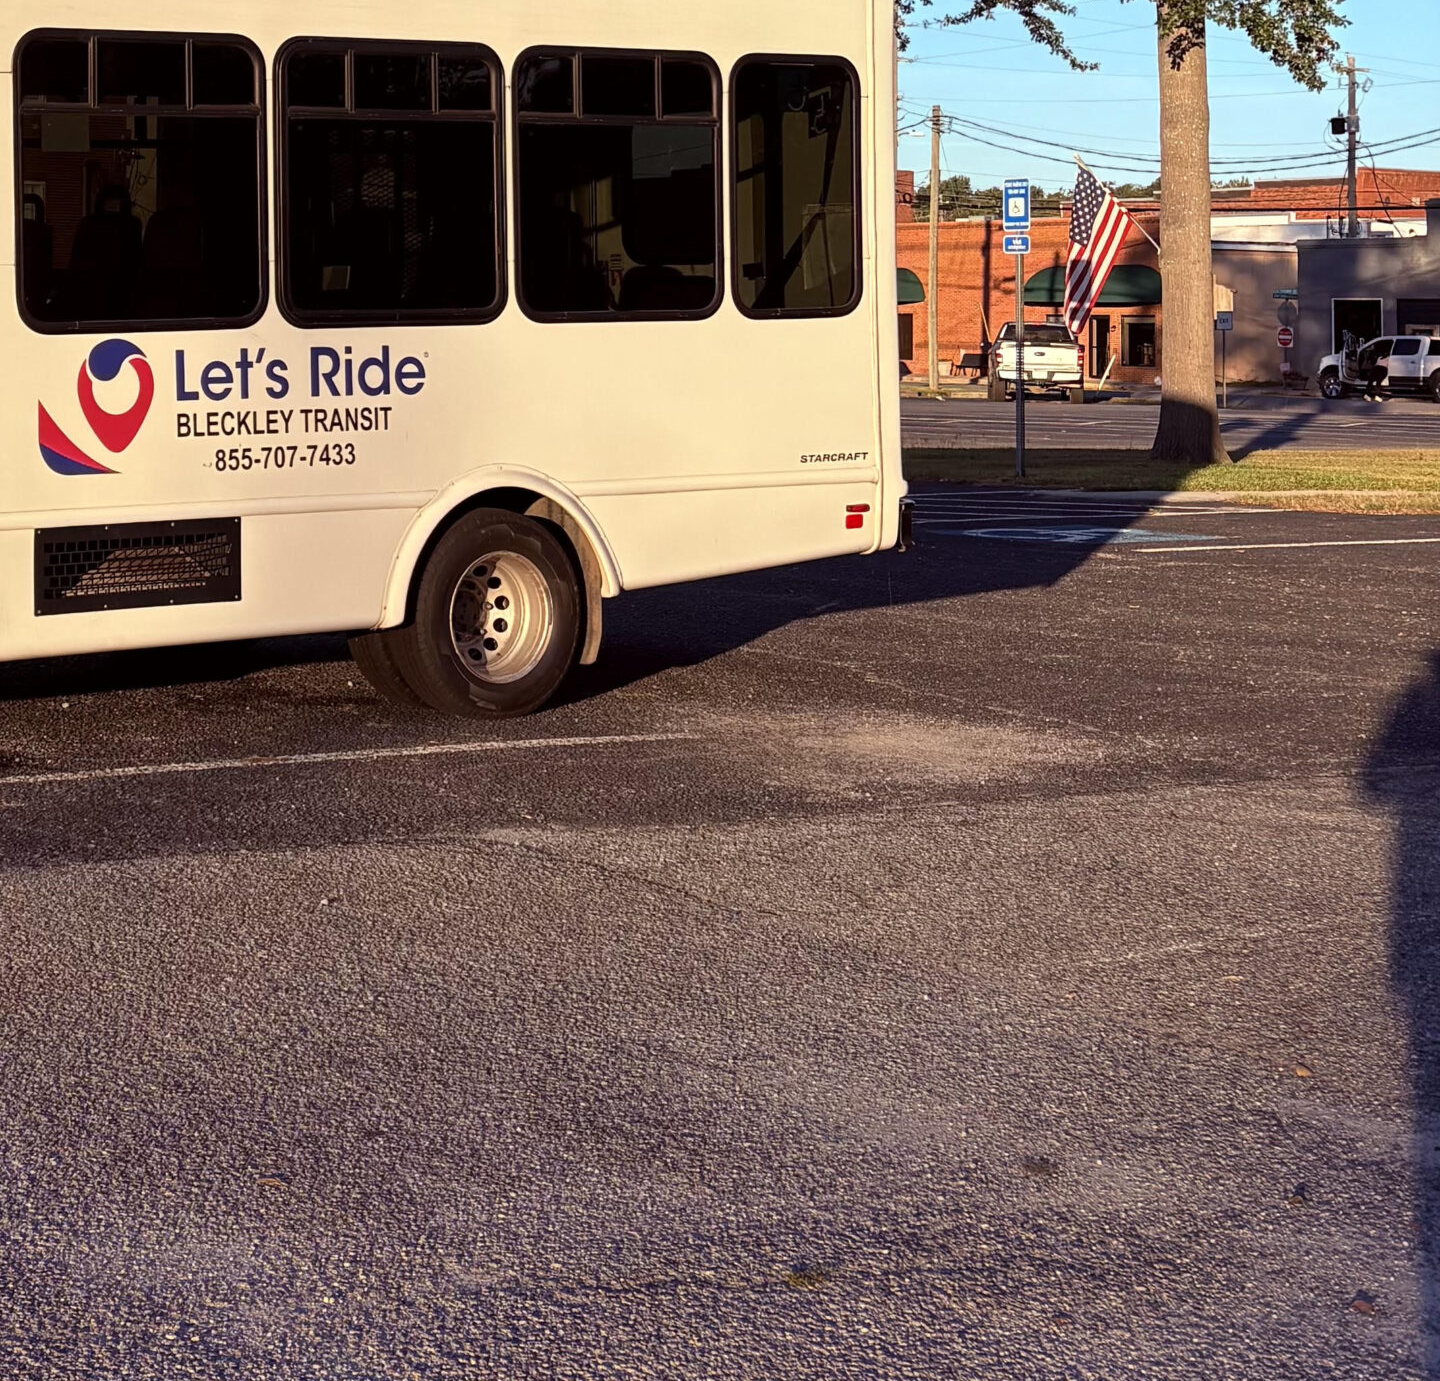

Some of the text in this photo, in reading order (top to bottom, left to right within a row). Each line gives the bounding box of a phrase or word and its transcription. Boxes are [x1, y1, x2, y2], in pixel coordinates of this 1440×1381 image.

[176, 345, 426, 401] Let's Ride
[176, 406, 392, 437] BLECKLEY TRANSIT
[215, 443, 356, 471] 855-707-7433
[800, 452, 868, 463] STARCRAFT
